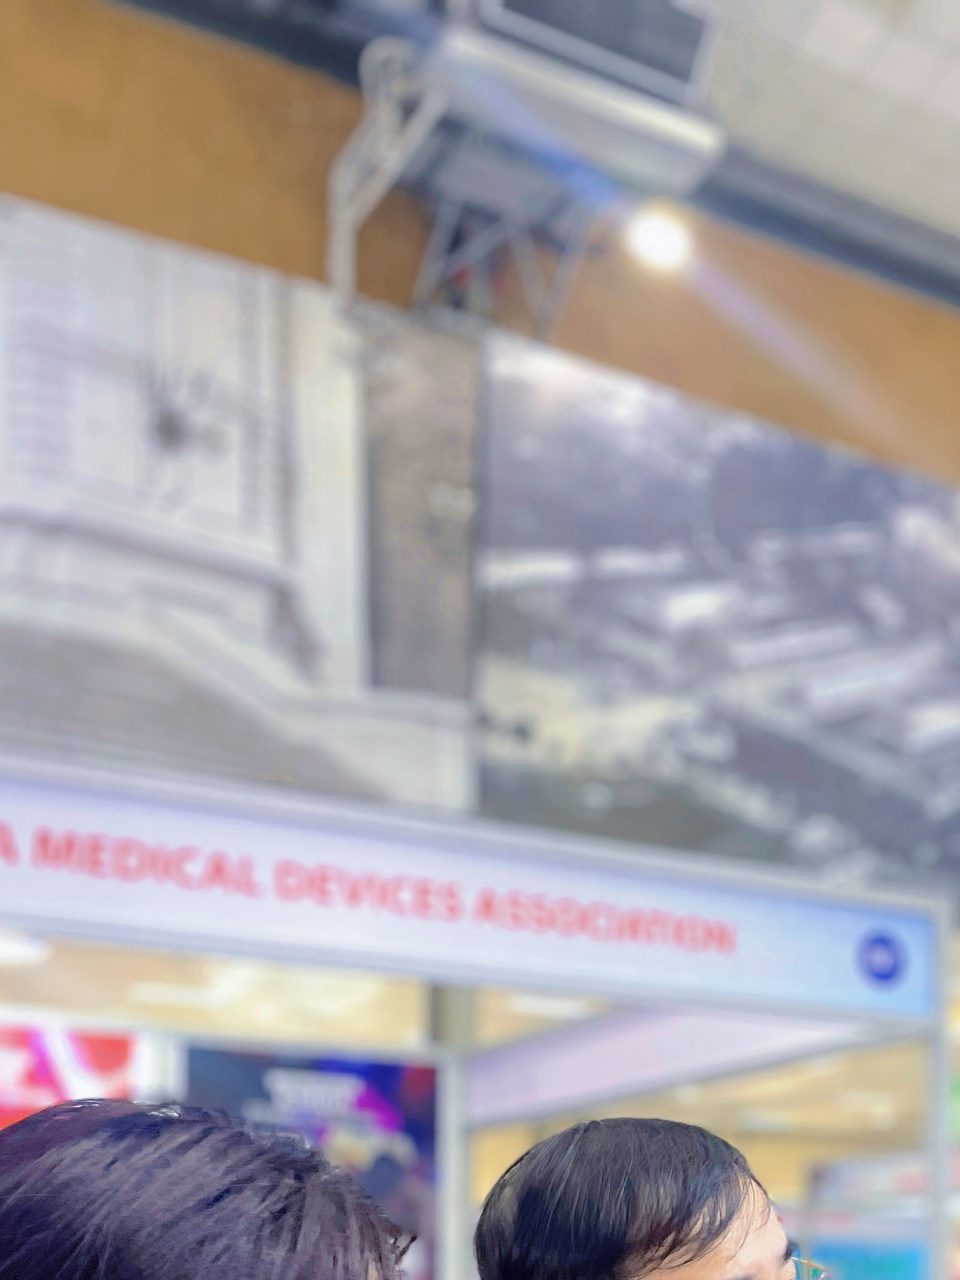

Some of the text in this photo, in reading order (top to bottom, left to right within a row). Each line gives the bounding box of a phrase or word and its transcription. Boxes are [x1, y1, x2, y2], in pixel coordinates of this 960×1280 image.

[32, 826, 263, 898] MEDICAL
[272, 858, 464, 922] DEVICES
[474, 887, 738, 955] ASSOCIATION
